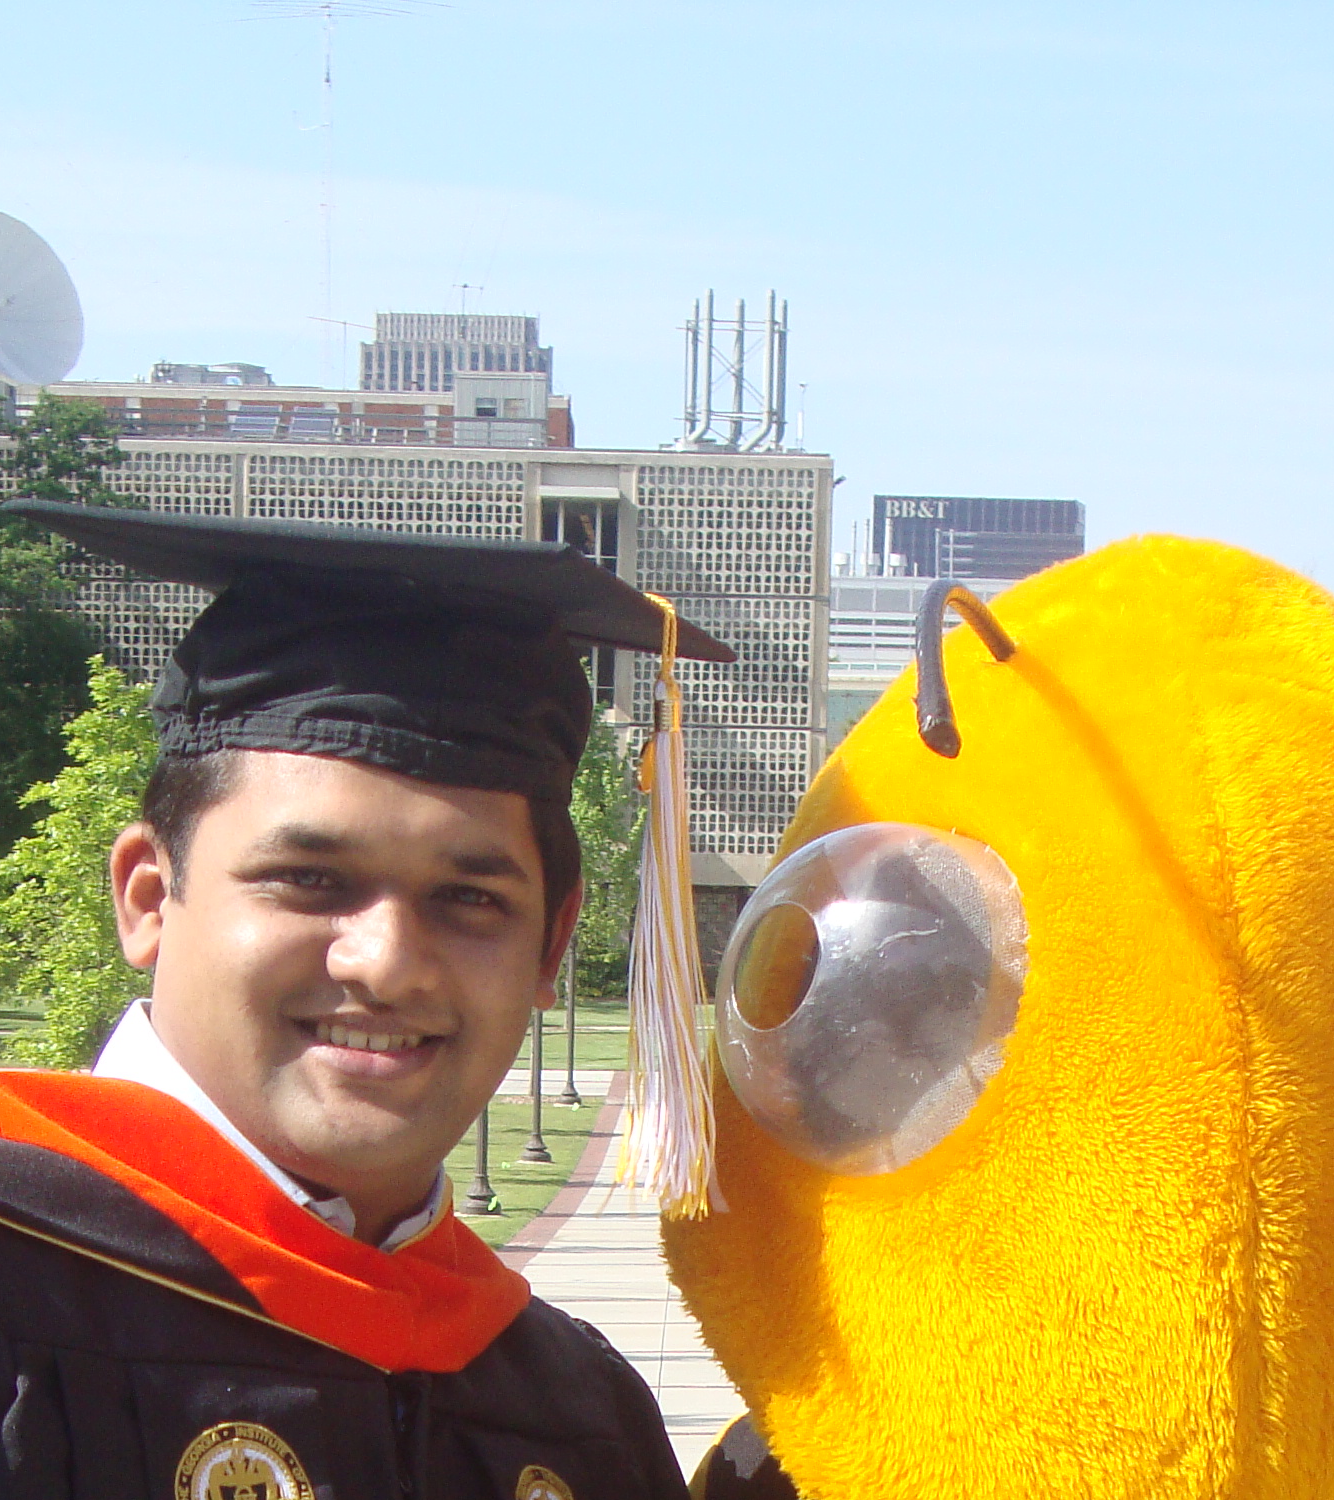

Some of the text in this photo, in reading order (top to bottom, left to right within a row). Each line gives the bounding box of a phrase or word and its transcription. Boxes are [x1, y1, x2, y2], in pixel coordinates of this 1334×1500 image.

[884, 499, 949, 519] BB&T
[183, 1431, 221, 1475] GEORGIA
[234, 1426, 286, 1459] INSTITUTE
